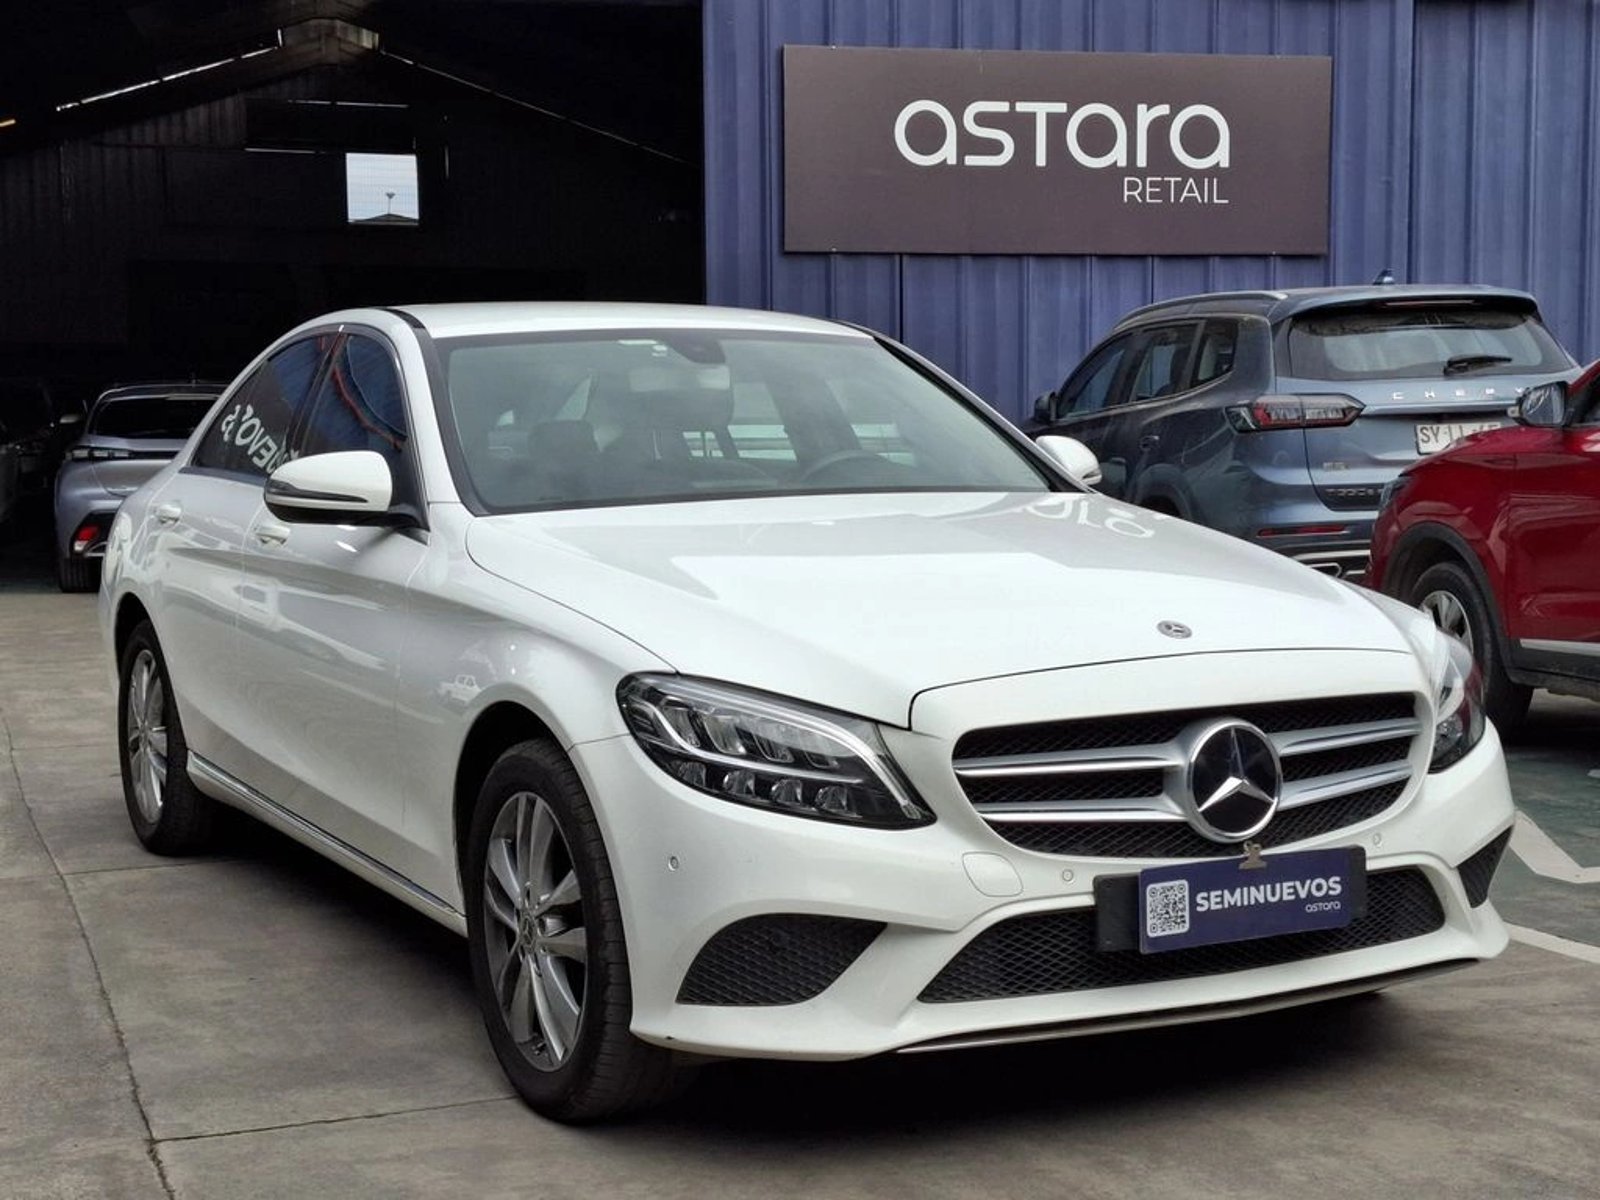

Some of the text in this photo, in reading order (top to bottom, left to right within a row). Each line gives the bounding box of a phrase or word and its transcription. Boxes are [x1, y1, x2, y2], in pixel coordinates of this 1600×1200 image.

[1124, 177, 1229, 204] RETAIL
[1392, 387, 1524, 400] CHERY
[1195, 876, 1342, 912] SEMINUEVOS
